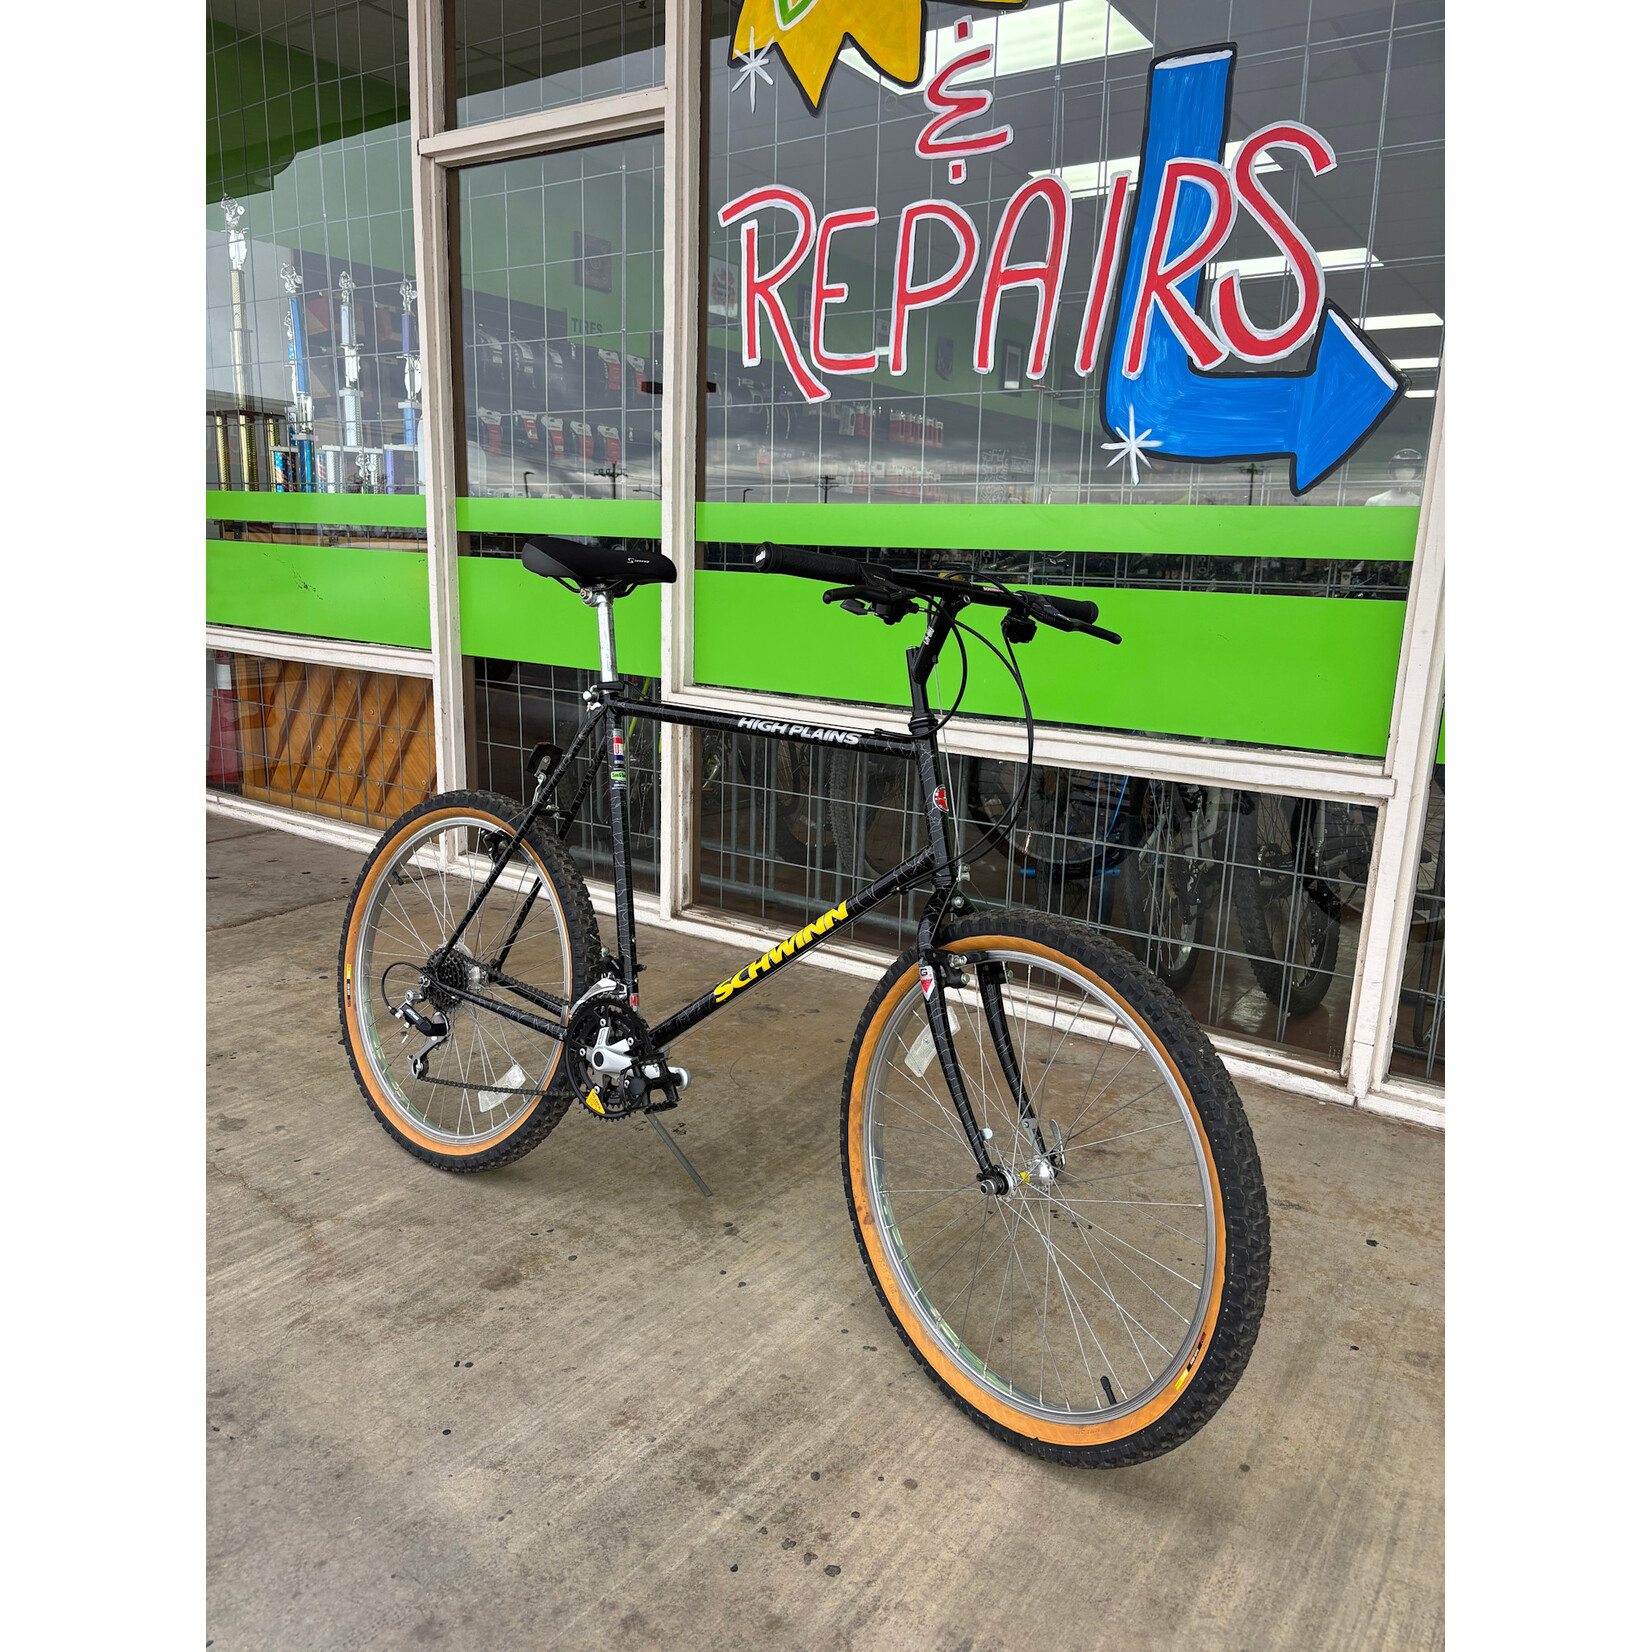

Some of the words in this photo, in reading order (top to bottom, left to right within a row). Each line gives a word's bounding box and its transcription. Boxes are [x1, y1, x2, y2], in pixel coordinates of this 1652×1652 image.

[718, 119, 1337, 404] REPAIRS
[571, 317, 603, 337] TIRES
[737, 717, 789, 735] HIGH
[788, 724, 862, 746] PLAINS
[713, 899, 849, 1003] SCHWINN
